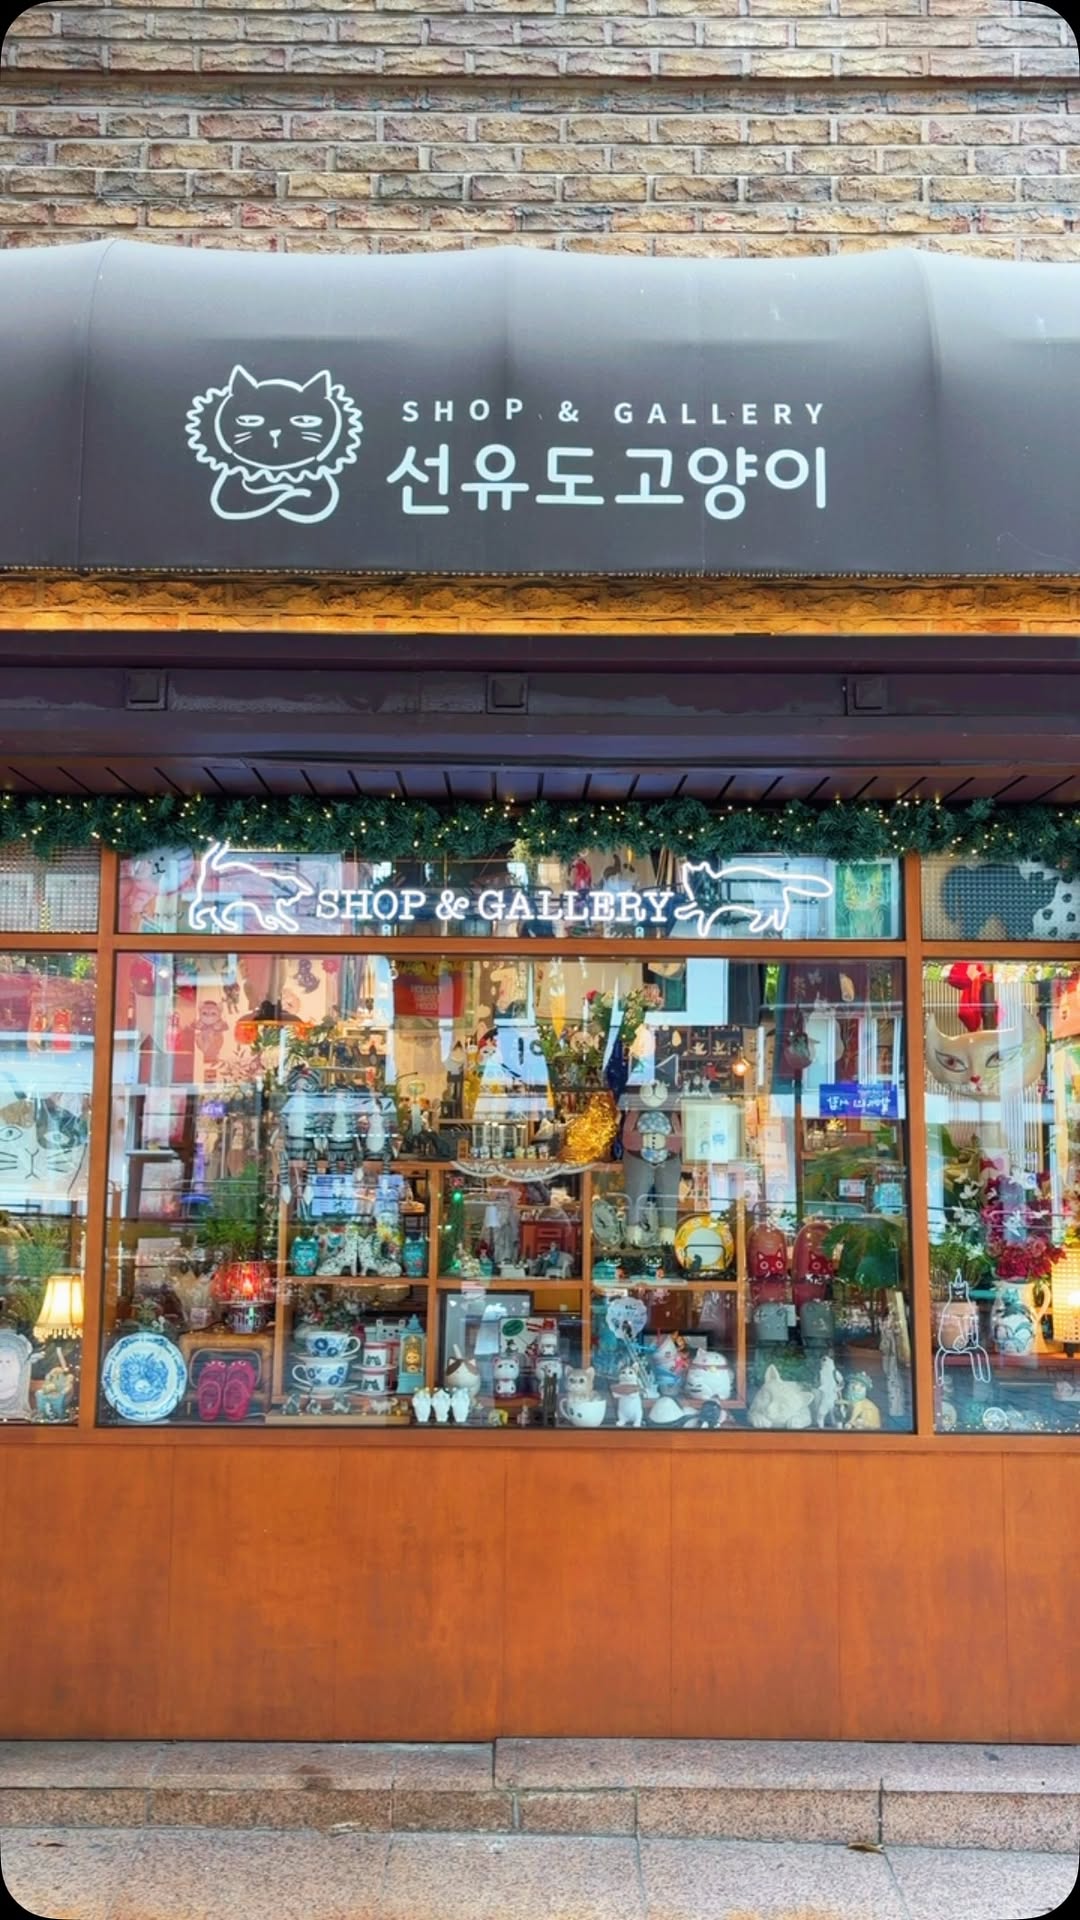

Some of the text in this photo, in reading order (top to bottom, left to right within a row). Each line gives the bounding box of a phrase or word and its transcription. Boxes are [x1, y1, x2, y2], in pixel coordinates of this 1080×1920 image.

[402, 399, 824, 425] SHOP & GALLERY
[386, 443, 827, 520] 선유도고양이
[316, 889, 675, 923] SHOP & GALLERY
